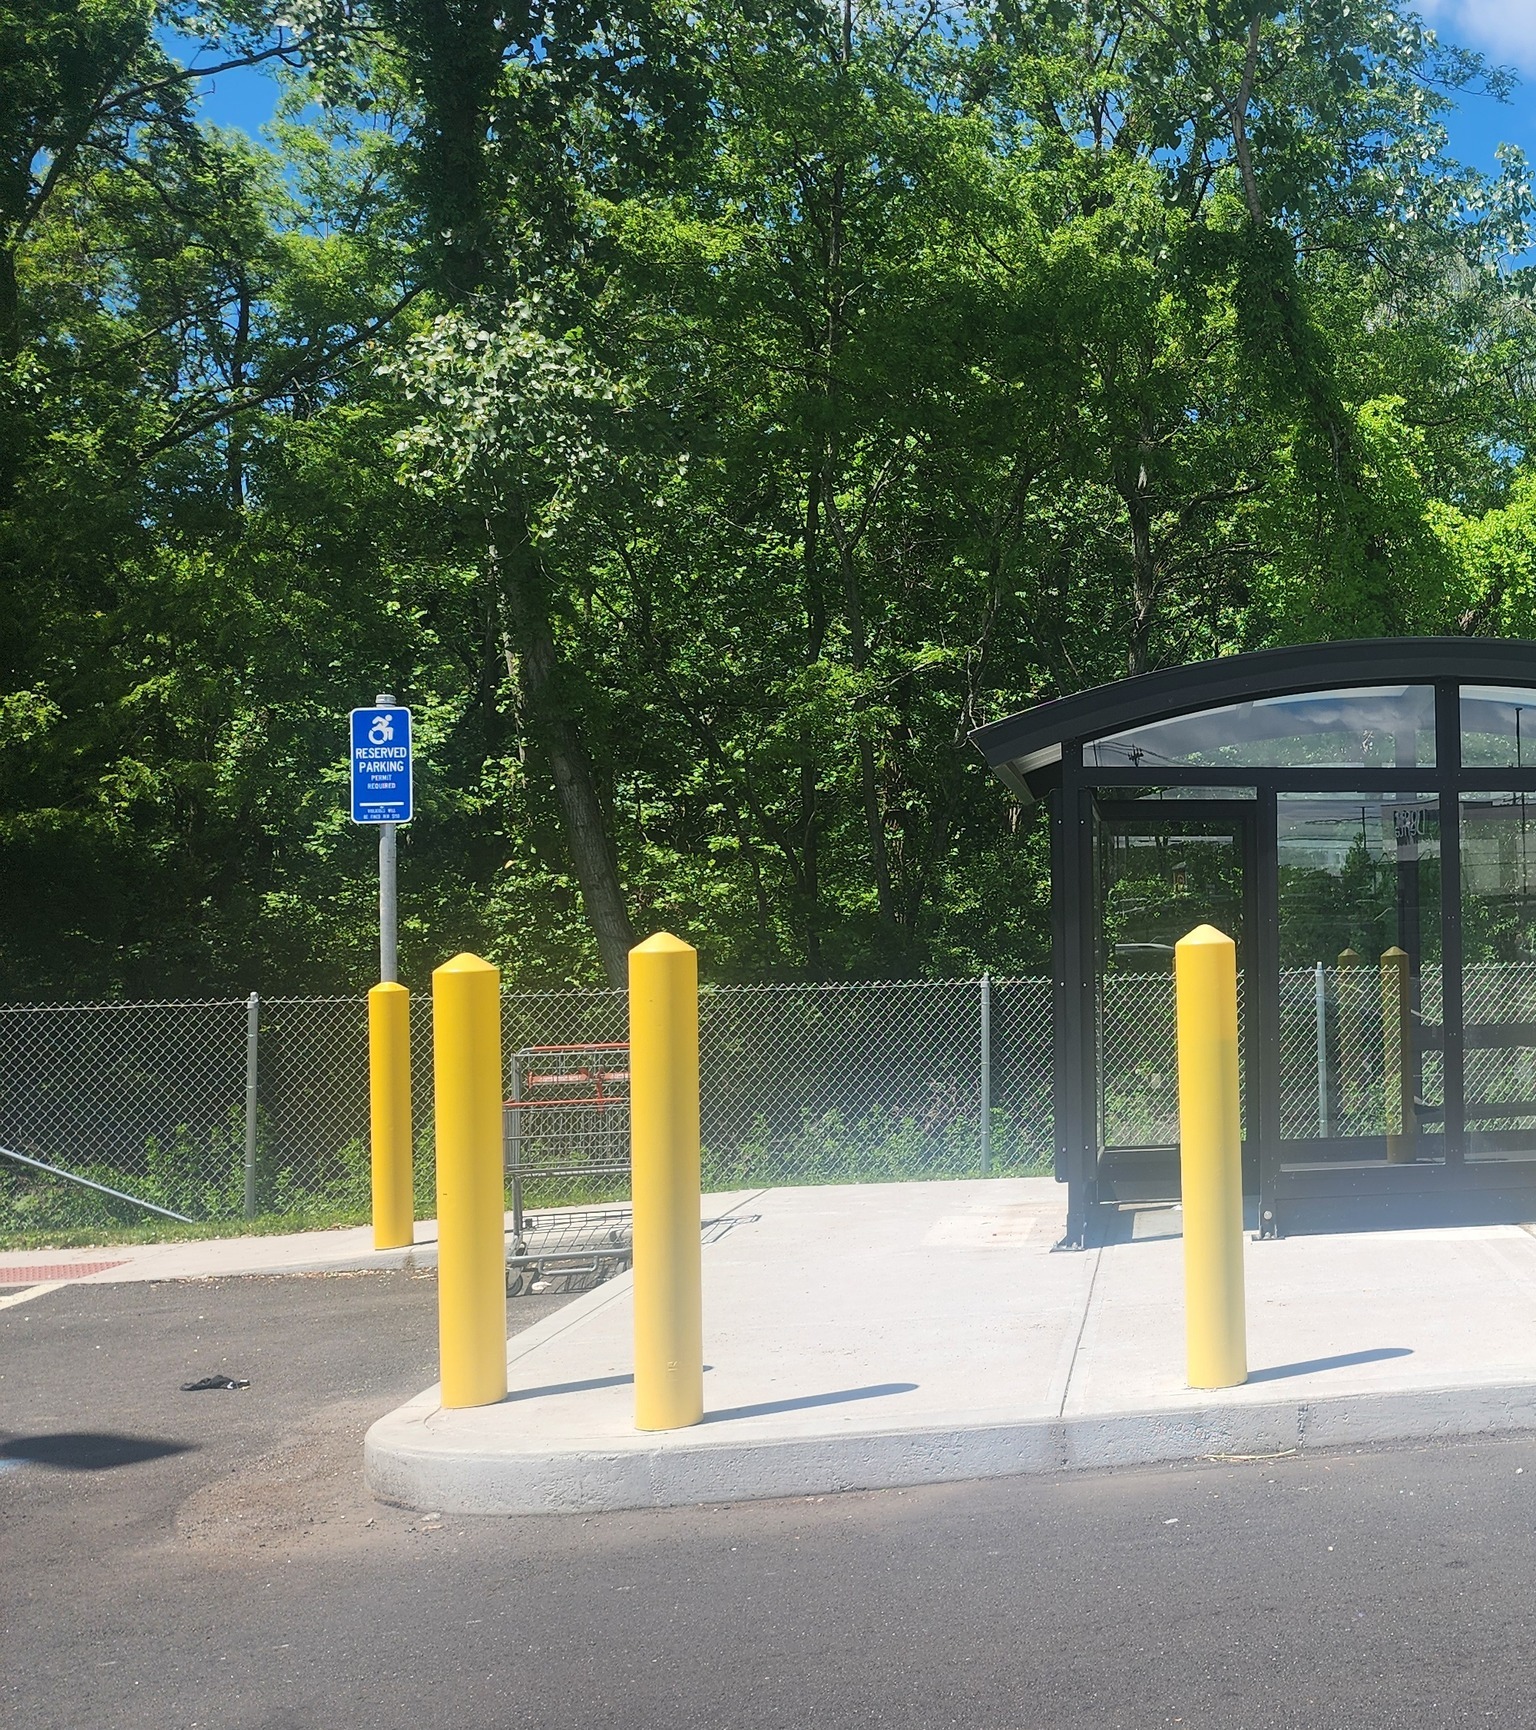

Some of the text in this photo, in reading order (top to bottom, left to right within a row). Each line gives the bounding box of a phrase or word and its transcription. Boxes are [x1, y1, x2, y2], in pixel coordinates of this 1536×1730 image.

[355, 747, 407, 759] RESERVED
[359, 761, 404, 773] PARKING
[367, 782, 396, 790] REQUIRED
